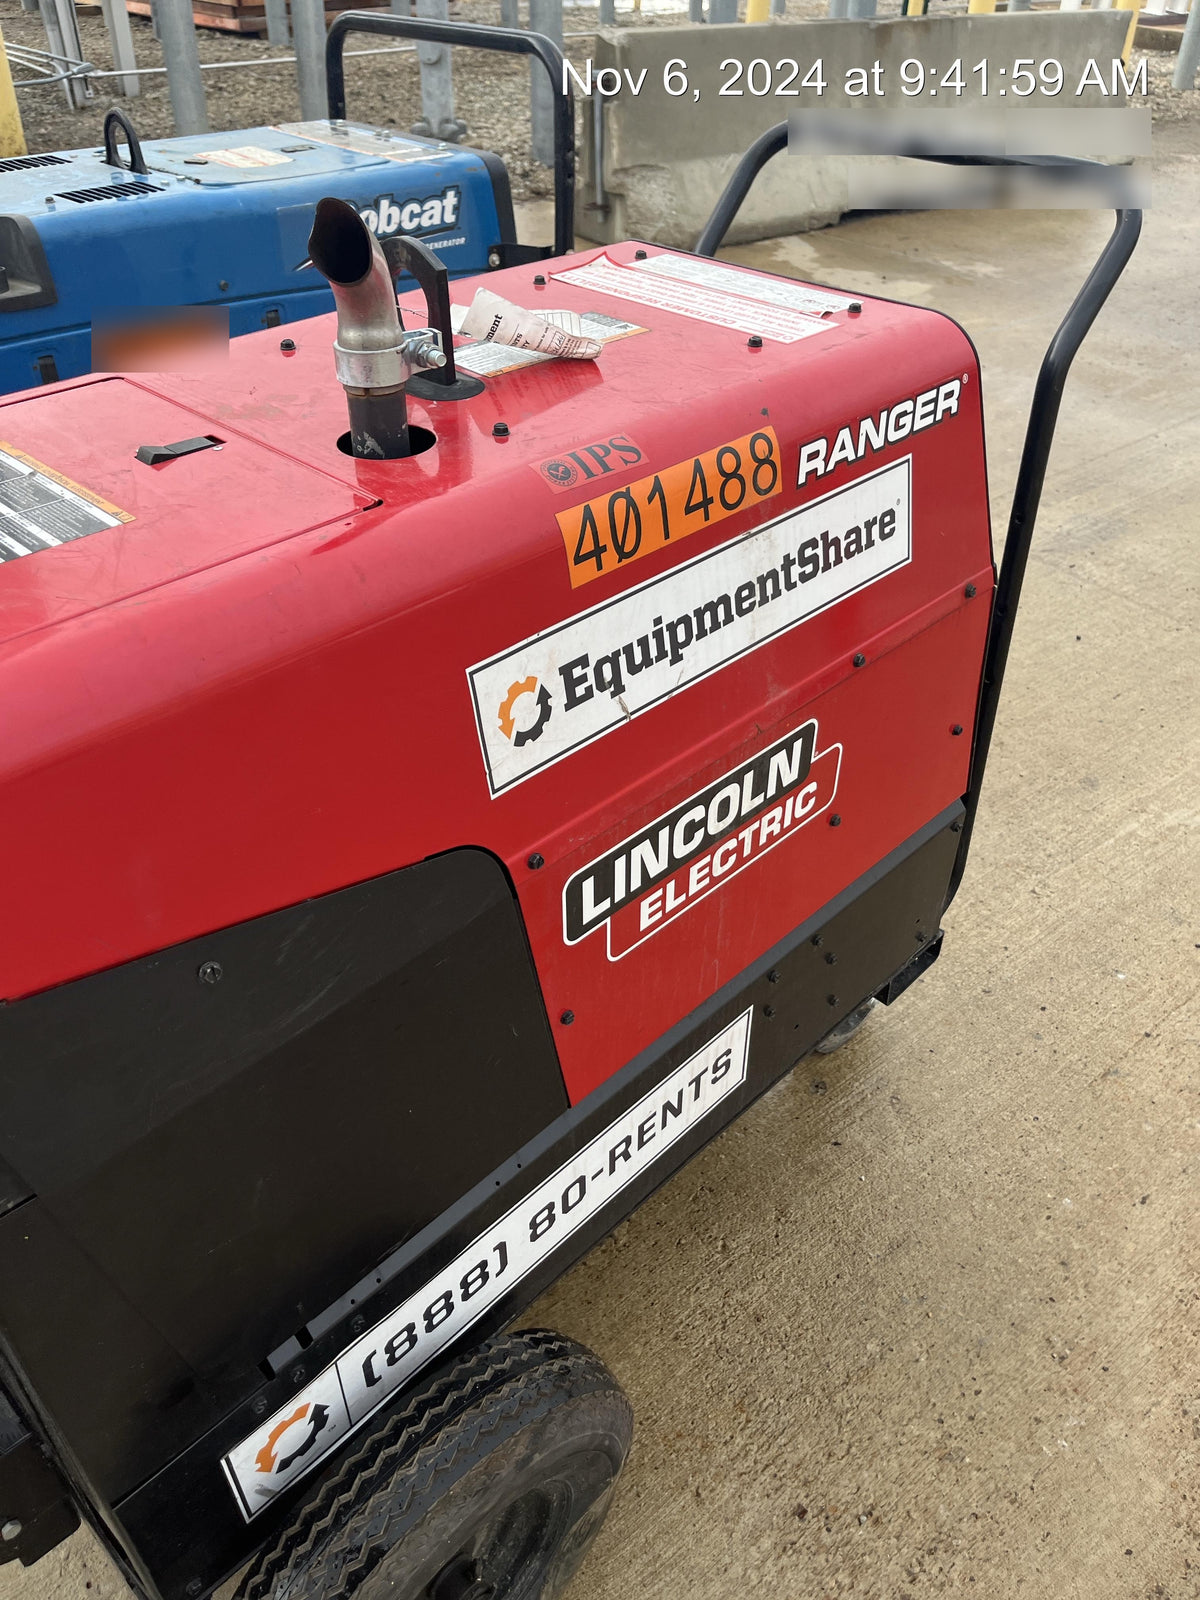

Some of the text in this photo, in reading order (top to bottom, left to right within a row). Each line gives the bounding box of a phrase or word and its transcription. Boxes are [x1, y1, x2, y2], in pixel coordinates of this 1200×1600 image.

[351, 189, 460, 235] obcat
[564, 435, 642, 481] IPS
[572, 431, 779, 573] 401488
[797, 378, 962, 485] RANGER
[558, 507, 896, 713] EquipmentShare
[581, 737, 804, 927] LINCOLN
[639, 781, 818, 933] ELECTRIC
[361, 1048, 733, 1389] (888) 80-RENTS
